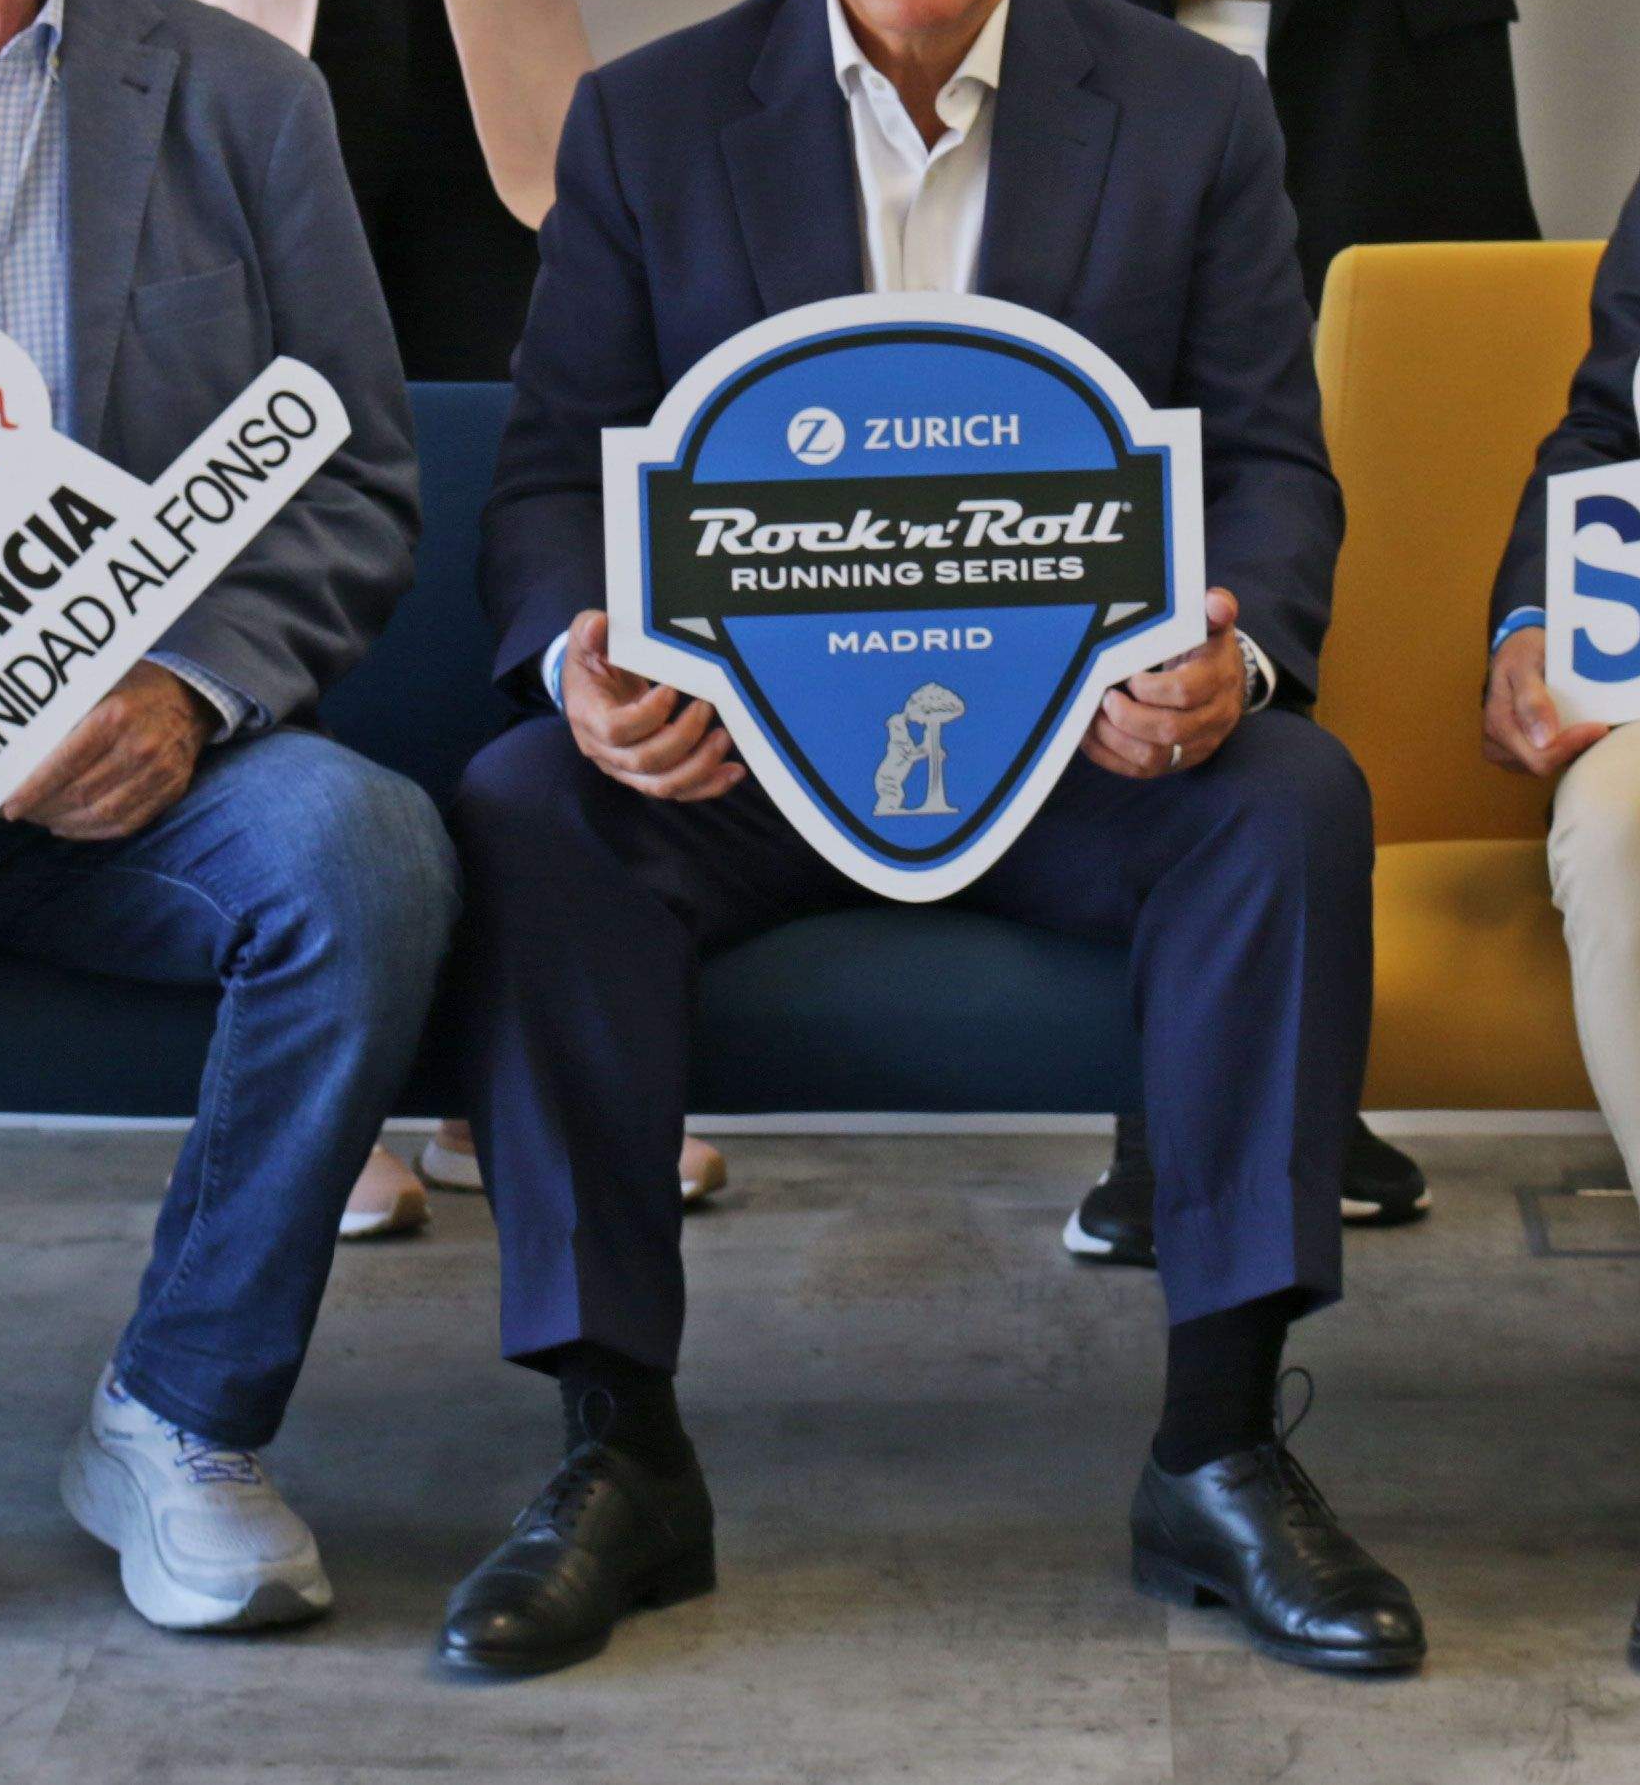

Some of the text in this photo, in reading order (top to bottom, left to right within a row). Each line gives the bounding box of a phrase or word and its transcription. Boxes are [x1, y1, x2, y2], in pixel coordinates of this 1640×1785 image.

[863, 415, 1020, 450] ZURICH
[117, 389, 319, 615] ALFONSO
[731, 556, 1084, 591] RUNNING SERIES
[828, 627, 993, 655] MADRID
